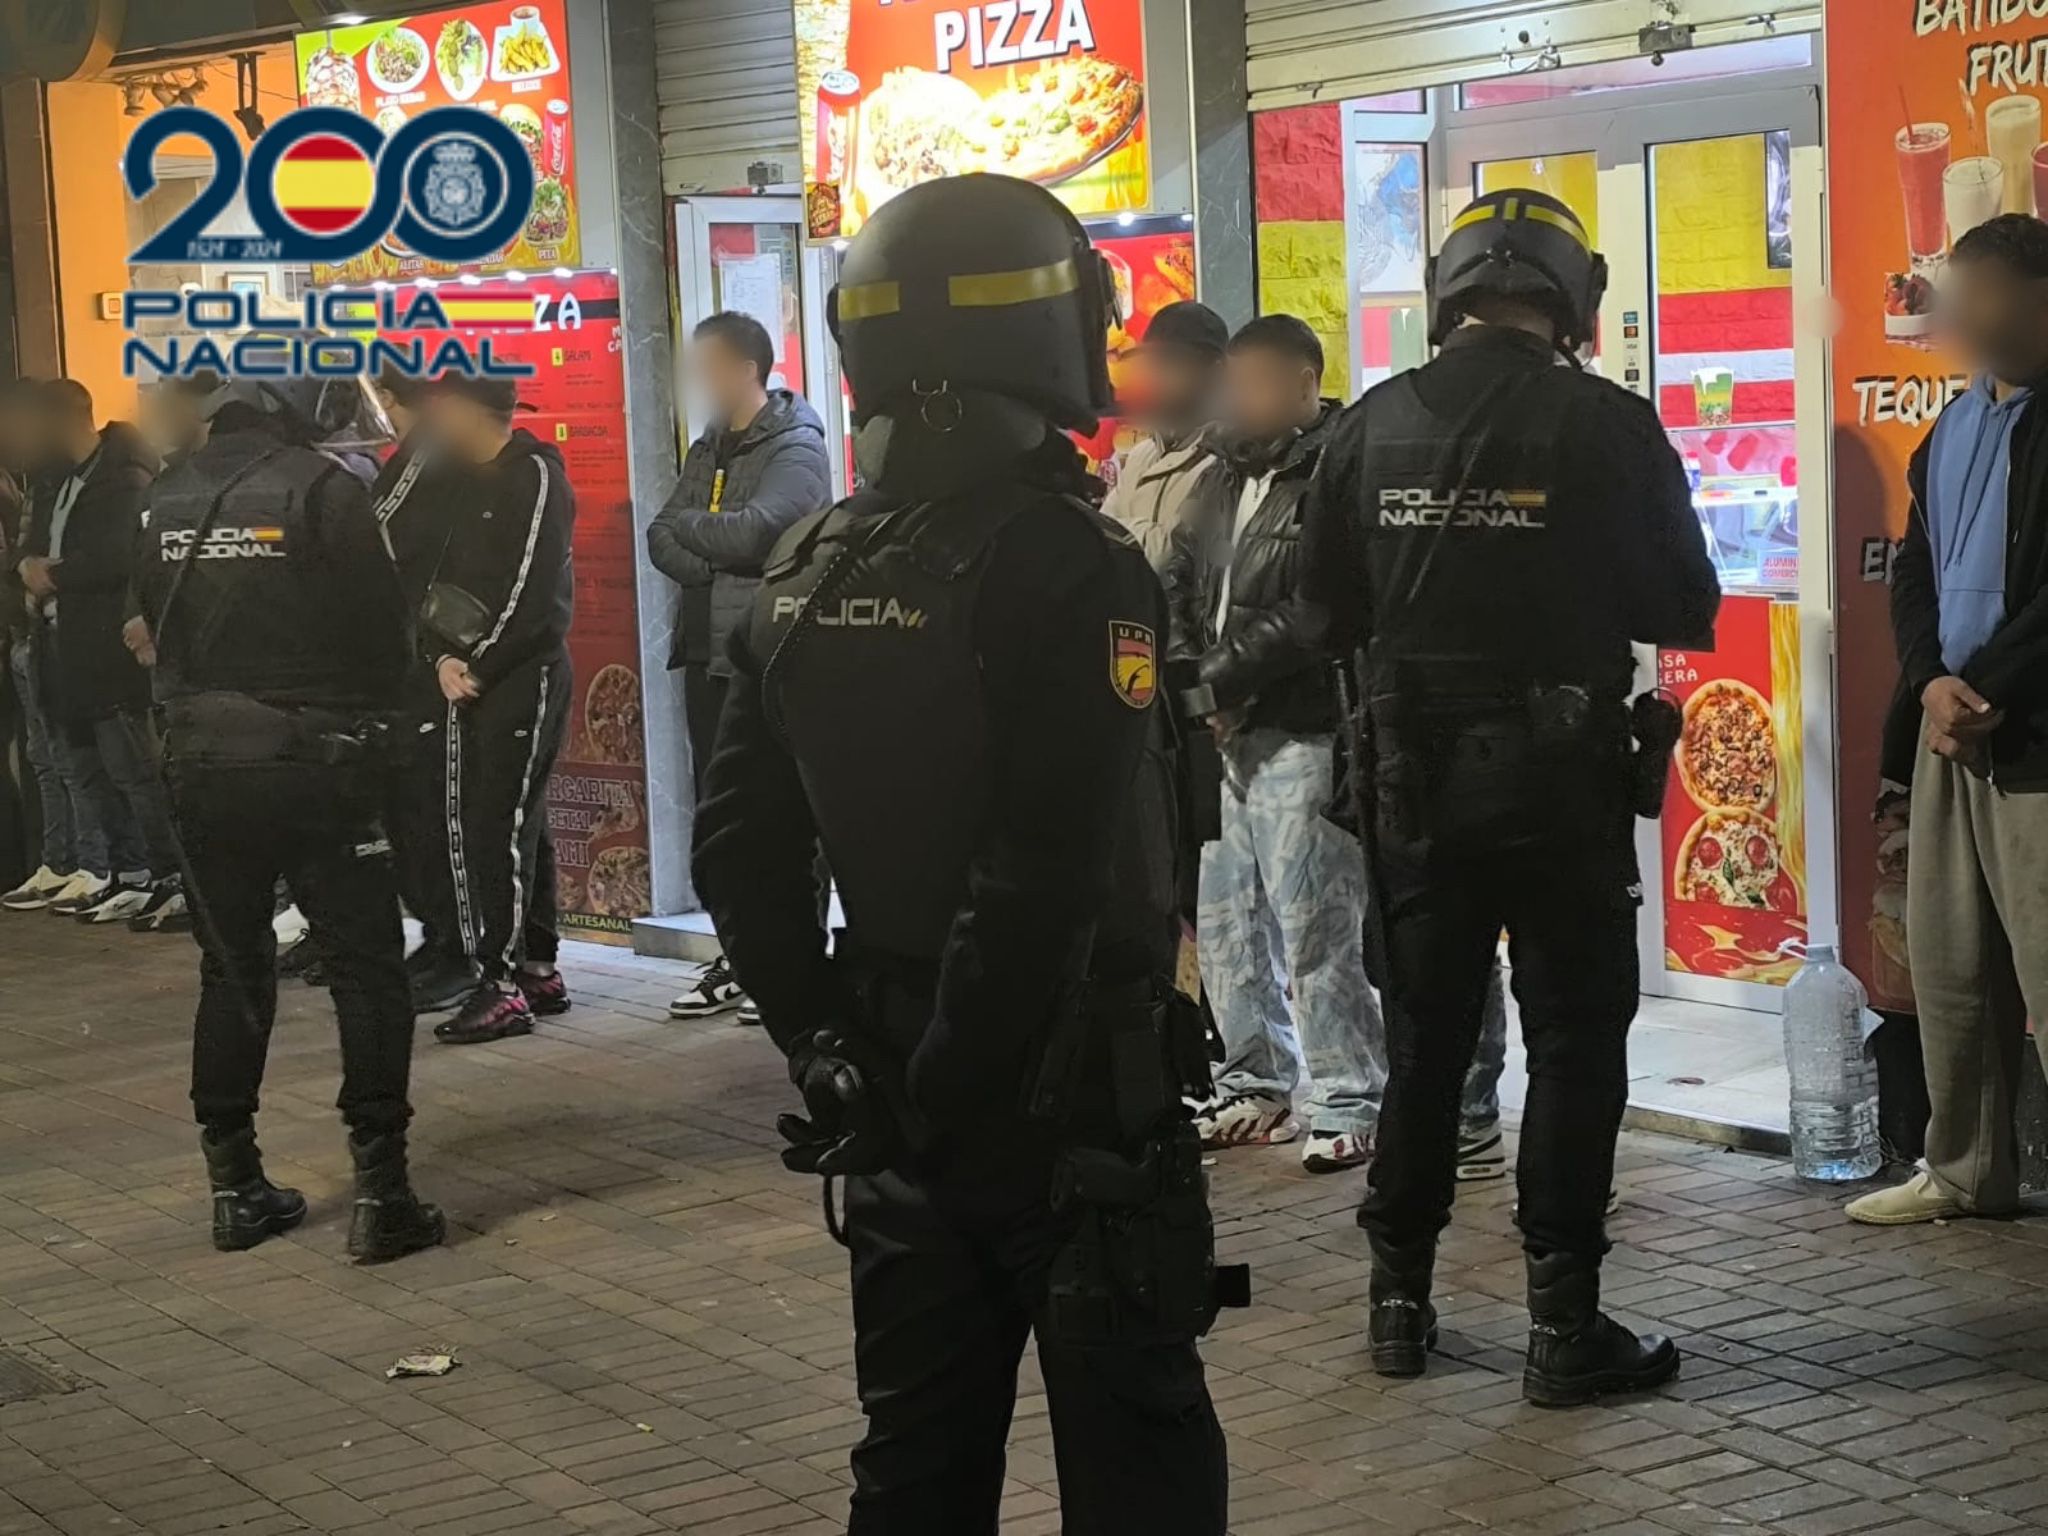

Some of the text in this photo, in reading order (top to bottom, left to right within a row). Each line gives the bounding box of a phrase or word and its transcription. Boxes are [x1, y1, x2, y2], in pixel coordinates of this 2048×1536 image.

[934, 0, 1096, 72] PIZZA
[772, 597, 905, 627] PLICIA
[546, 774, 634, 807] RGARITA
[563, 912, 633, 932] ARTESANAL
